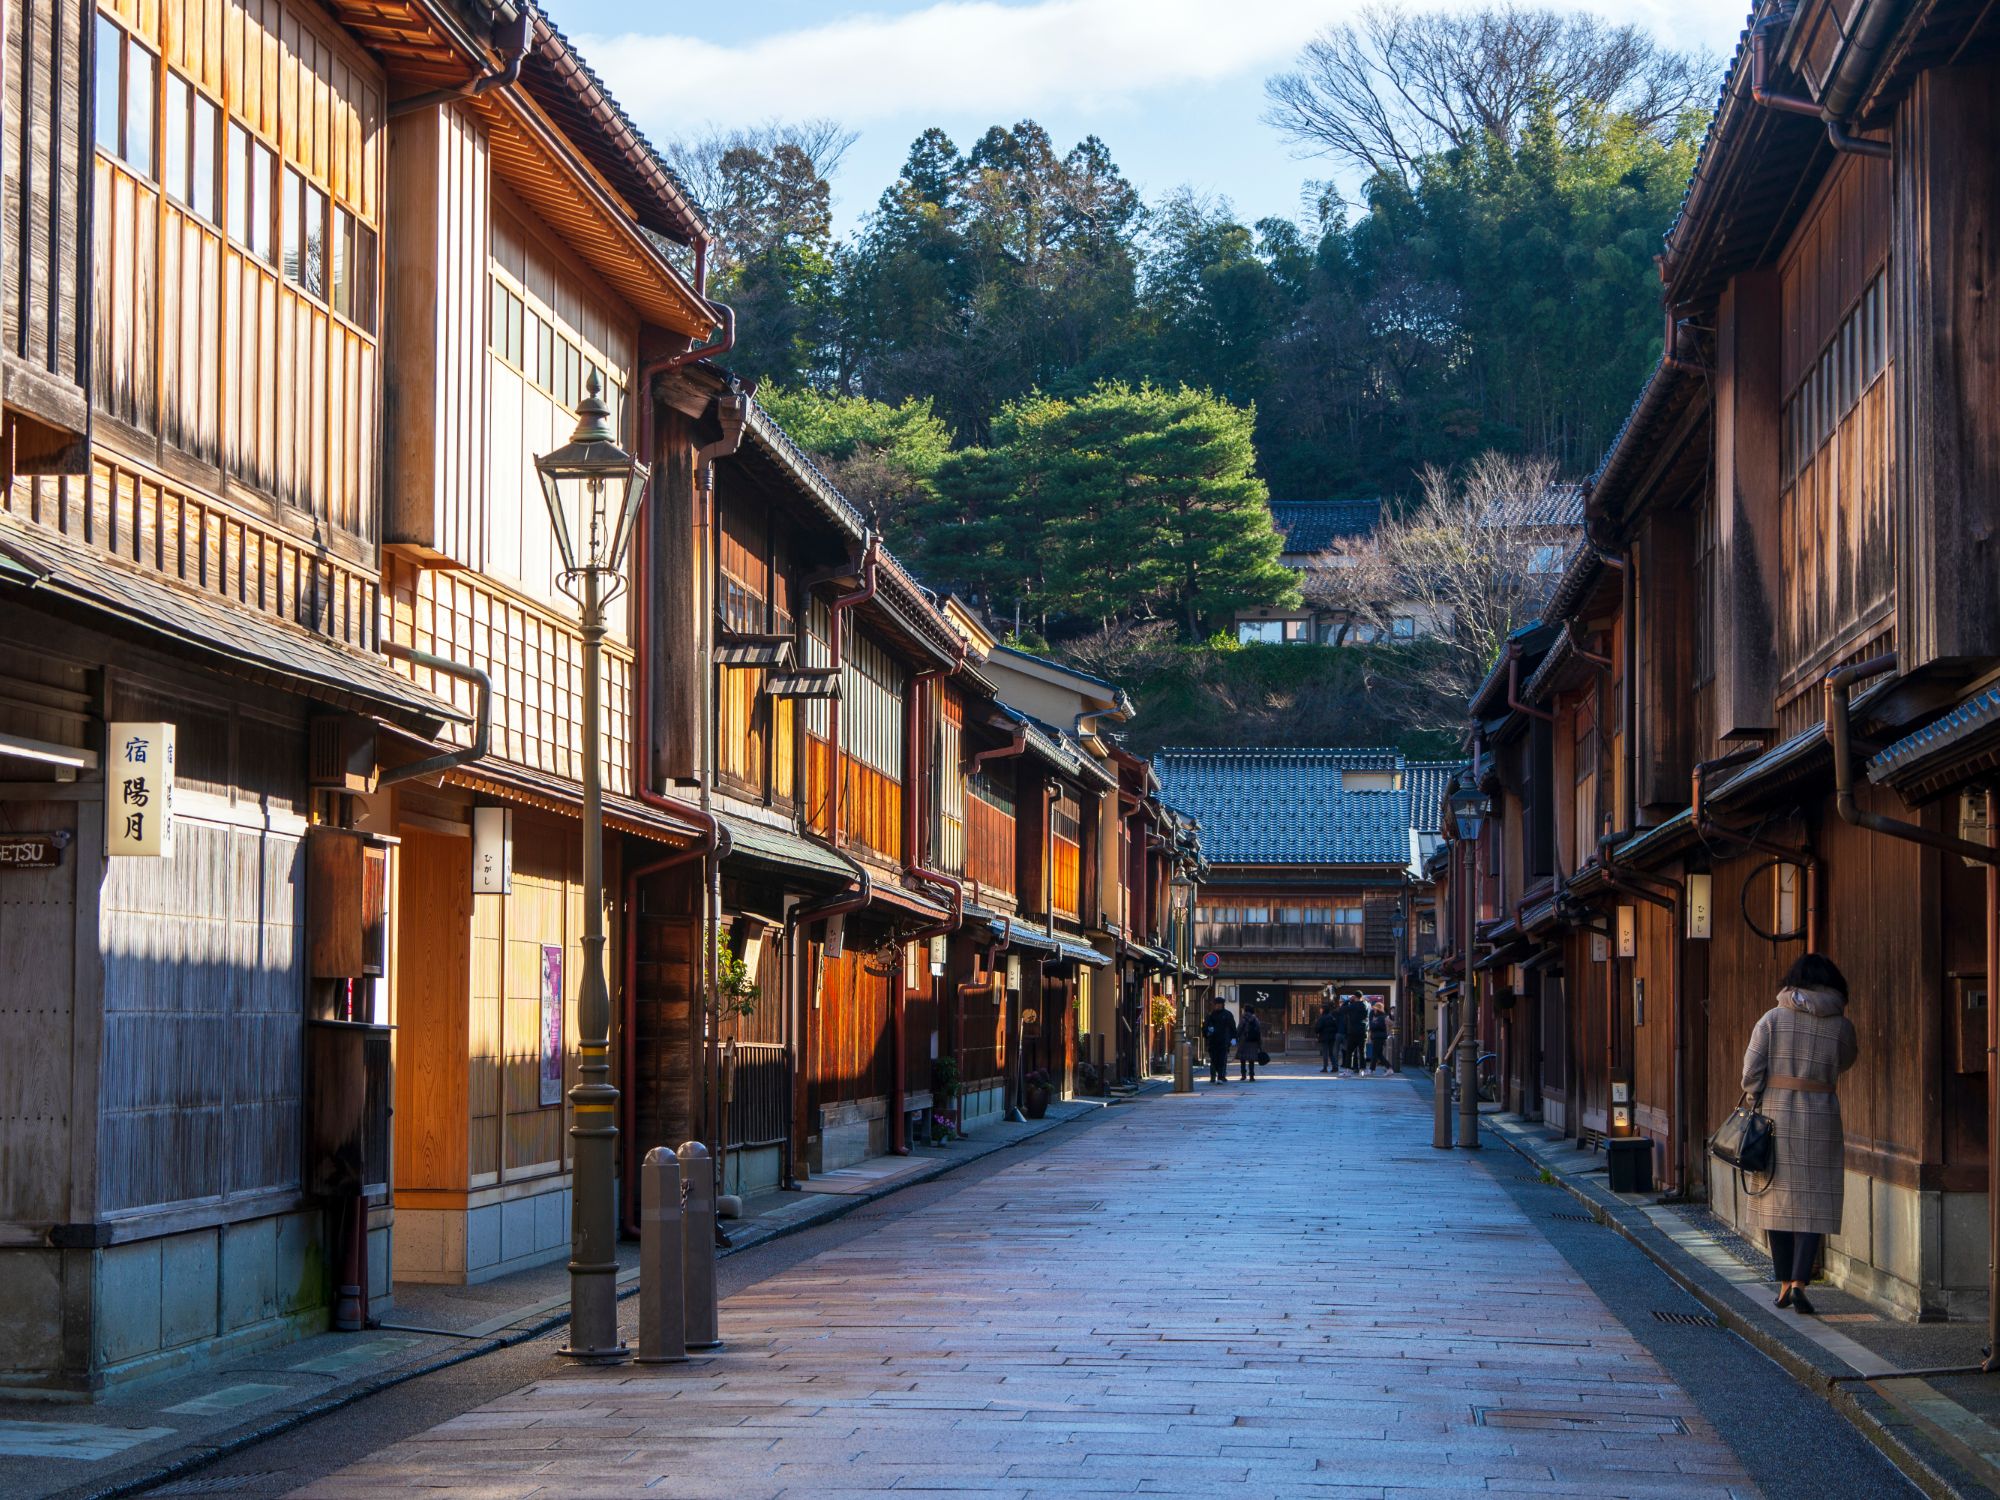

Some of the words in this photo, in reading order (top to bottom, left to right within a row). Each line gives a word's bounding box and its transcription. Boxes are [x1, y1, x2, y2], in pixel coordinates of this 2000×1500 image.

[123, 737, 150, 842] 宿陽月
[0, 843, 44, 862] ETSU
[484, 854, 493, 885] ひがし
[1697, 905, 1705, 933] ひがし
